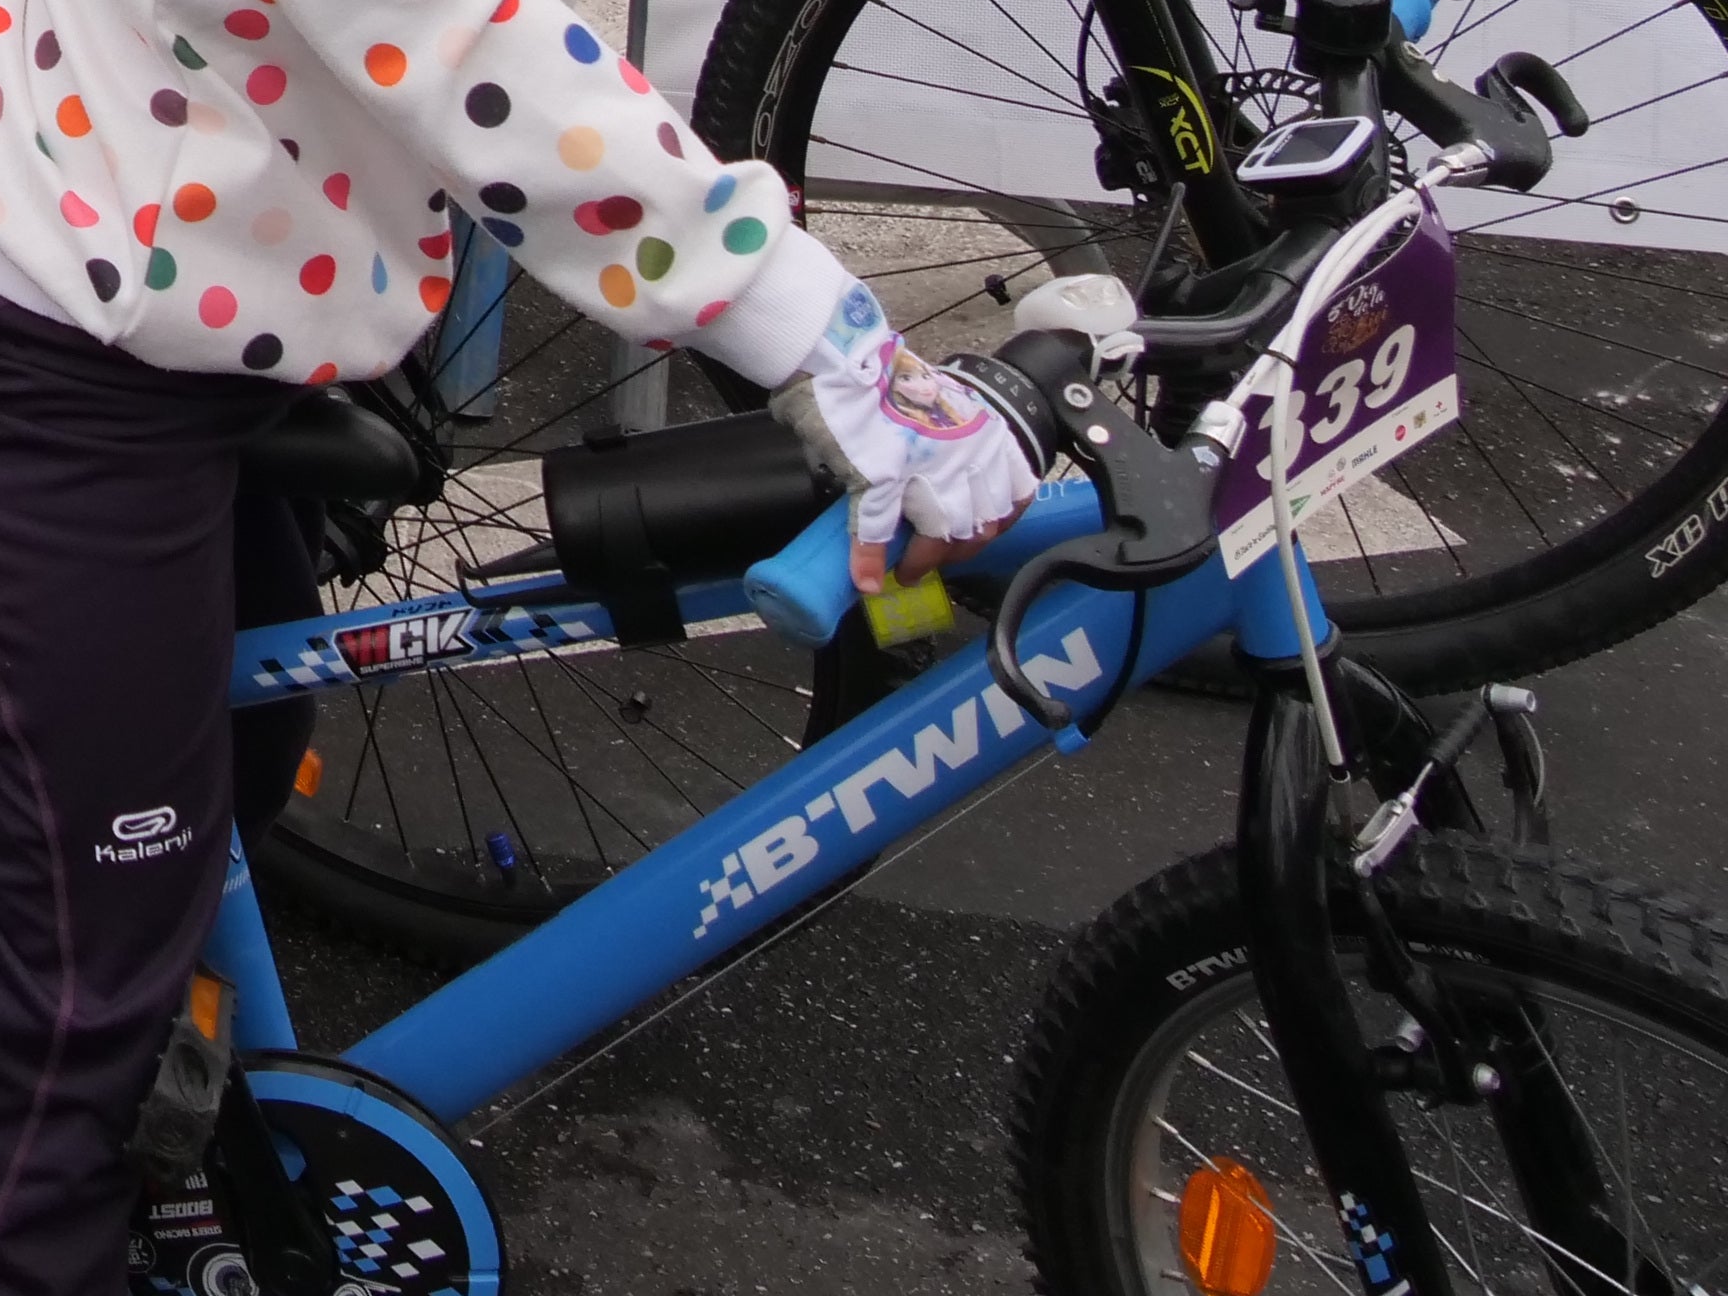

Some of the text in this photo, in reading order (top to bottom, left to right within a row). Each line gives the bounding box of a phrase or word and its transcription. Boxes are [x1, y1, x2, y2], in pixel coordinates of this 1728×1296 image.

[1169, 104, 1211, 176] XCT
[1255, 323, 1416, 482] 339
[94, 826, 194, 864] Kalenji
